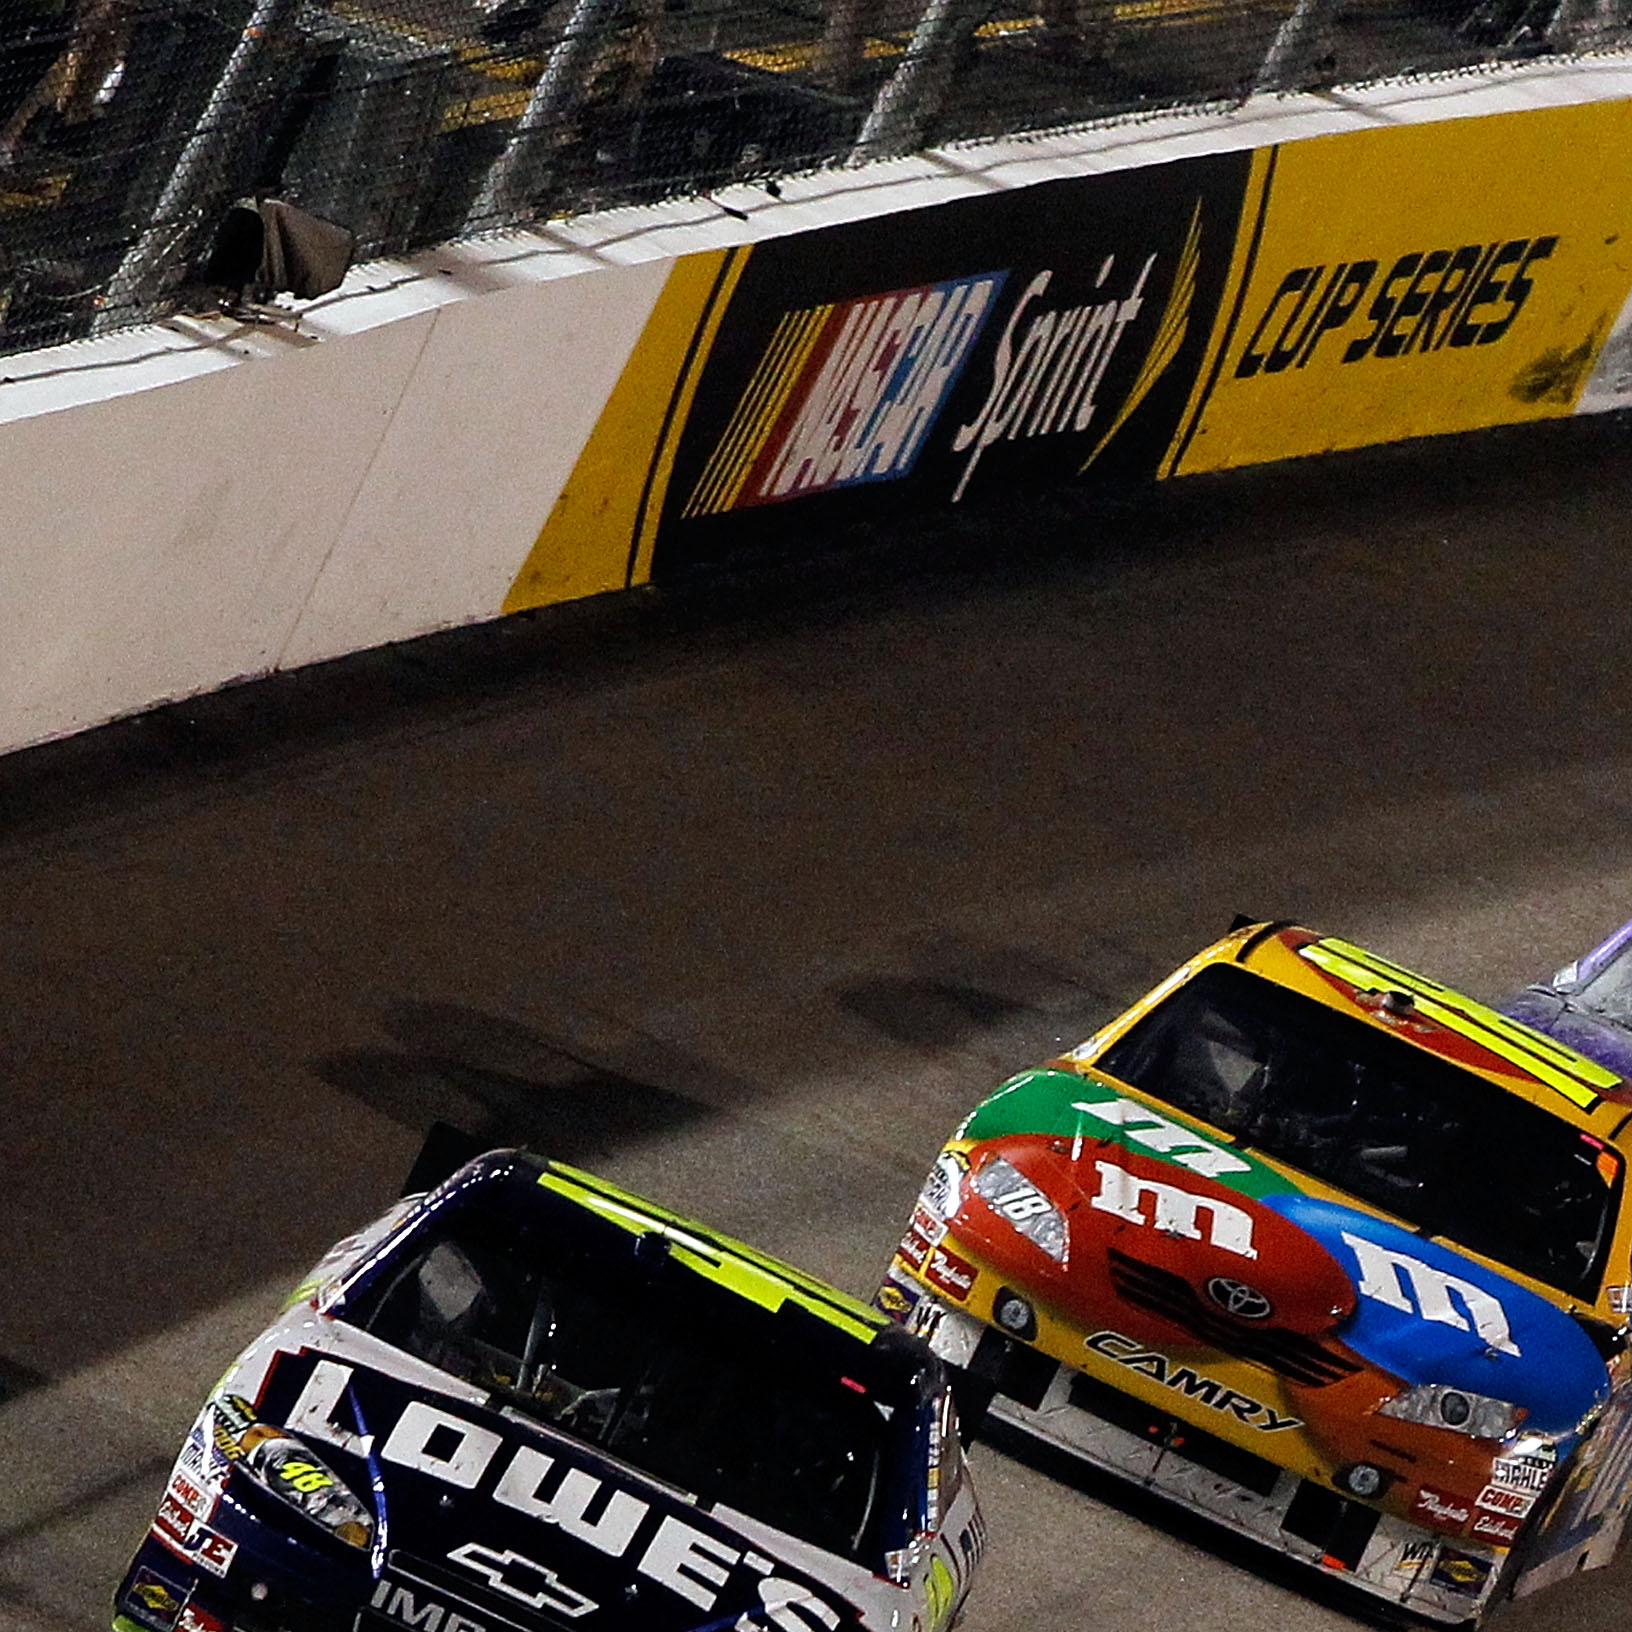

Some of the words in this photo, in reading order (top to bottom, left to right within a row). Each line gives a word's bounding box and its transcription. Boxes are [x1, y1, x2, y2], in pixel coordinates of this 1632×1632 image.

[1235, 259, 1378, 378] CUP
[1343, 236, 1559, 364] SERIES
[759, 280, 994, 496] NASCAR
[953, 253, 1157, 502] Sprint
[993, 1187, 1052, 1221] 18
[1085, 1331, 1303, 1433] CAMRY
[280, 1462, 333, 1492] 48
